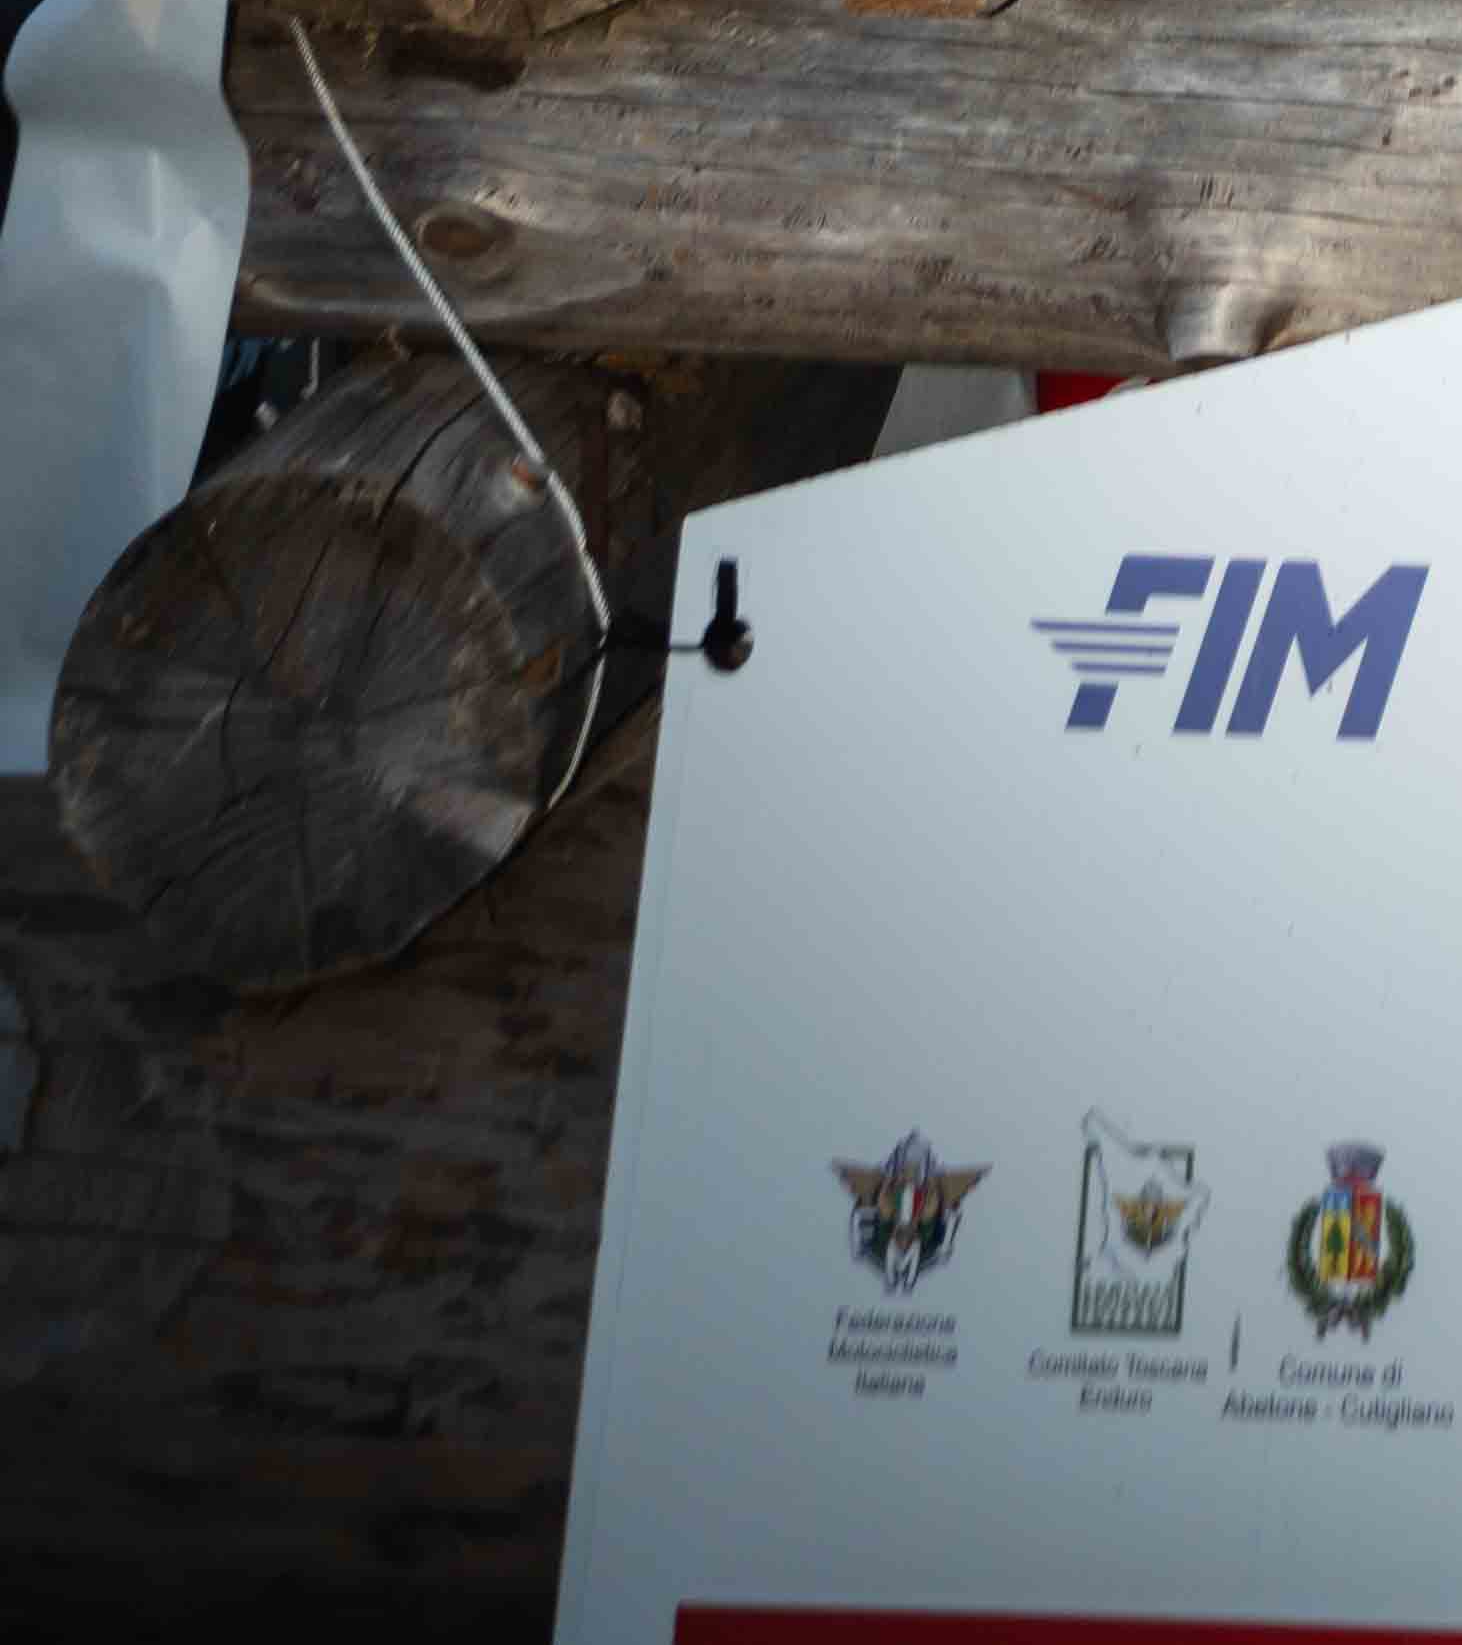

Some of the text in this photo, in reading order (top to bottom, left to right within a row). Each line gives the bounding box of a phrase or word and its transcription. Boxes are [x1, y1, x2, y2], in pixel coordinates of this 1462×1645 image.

[1030, 553, 1431, 742] FIM
[1278, 1353, 1405, 1388] Comune di
[1220, 1388, 1318, 1422] Abetone
[1339, 1391, 1455, 1432] Cutigliano
